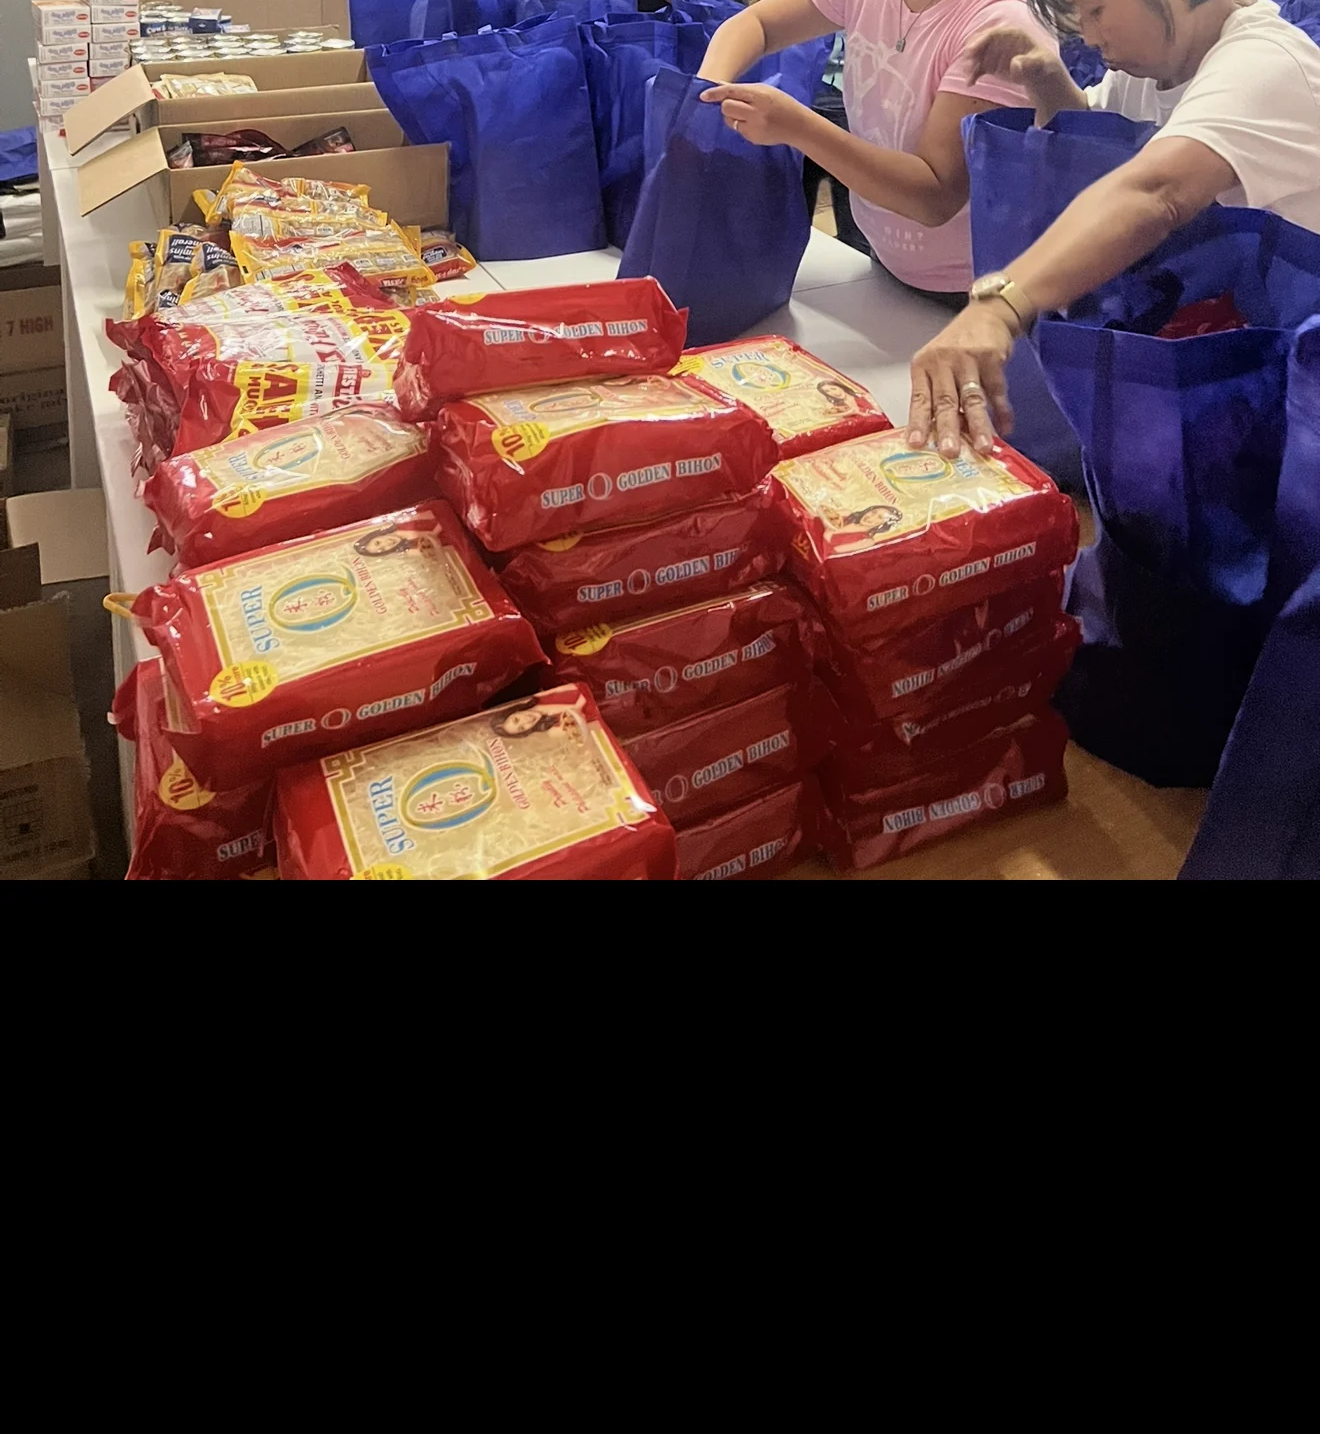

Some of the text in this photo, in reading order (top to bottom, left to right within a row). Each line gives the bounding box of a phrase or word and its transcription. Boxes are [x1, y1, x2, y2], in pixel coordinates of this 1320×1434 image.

[6, 316, 54, 337] 7 HIGH
[484, 329, 525, 346] SUPER
[606, 319, 648, 336] BIHON
[711, 350, 772, 371] SUPER
[541, 485, 585, 508] SUPER
[617, 464, 671, 491] GOLDEN
[676, 452, 722, 476] BIHON
[876, 481, 899, 504] BIHON
[353, 556, 388, 614] GOLDEN BIHON
[578, 580, 624, 602] SUPER
[656, 556, 710, 584] GOLDEN
[867, 586, 909, 612] SUPER
[939, 557, 991, 587] GOLDEN
[994, 542, 1036, 568] BIHON
[240, 584, 280, 653] SUPER
[682, 649, 738, 681] GOLDEN
[741, 629, 777, 662] BIHON
[262, 718, 317, 749] SUPER
[357, 688, 427, 721] GOLDEN
[429, 662, 478, 701] BIHON
[891, 667, 936, 699] BIHON
[490, 738, 530, 809] GOLDEN BIHON
[691, 749, 744, 790] GOLDEN
[746, 729, 790, 764] BIHON
[368, 774, 415, 857] SUPER
[882, 805, 927, 835] BIHON
[928, 791, 982, 822] GOLDEN
